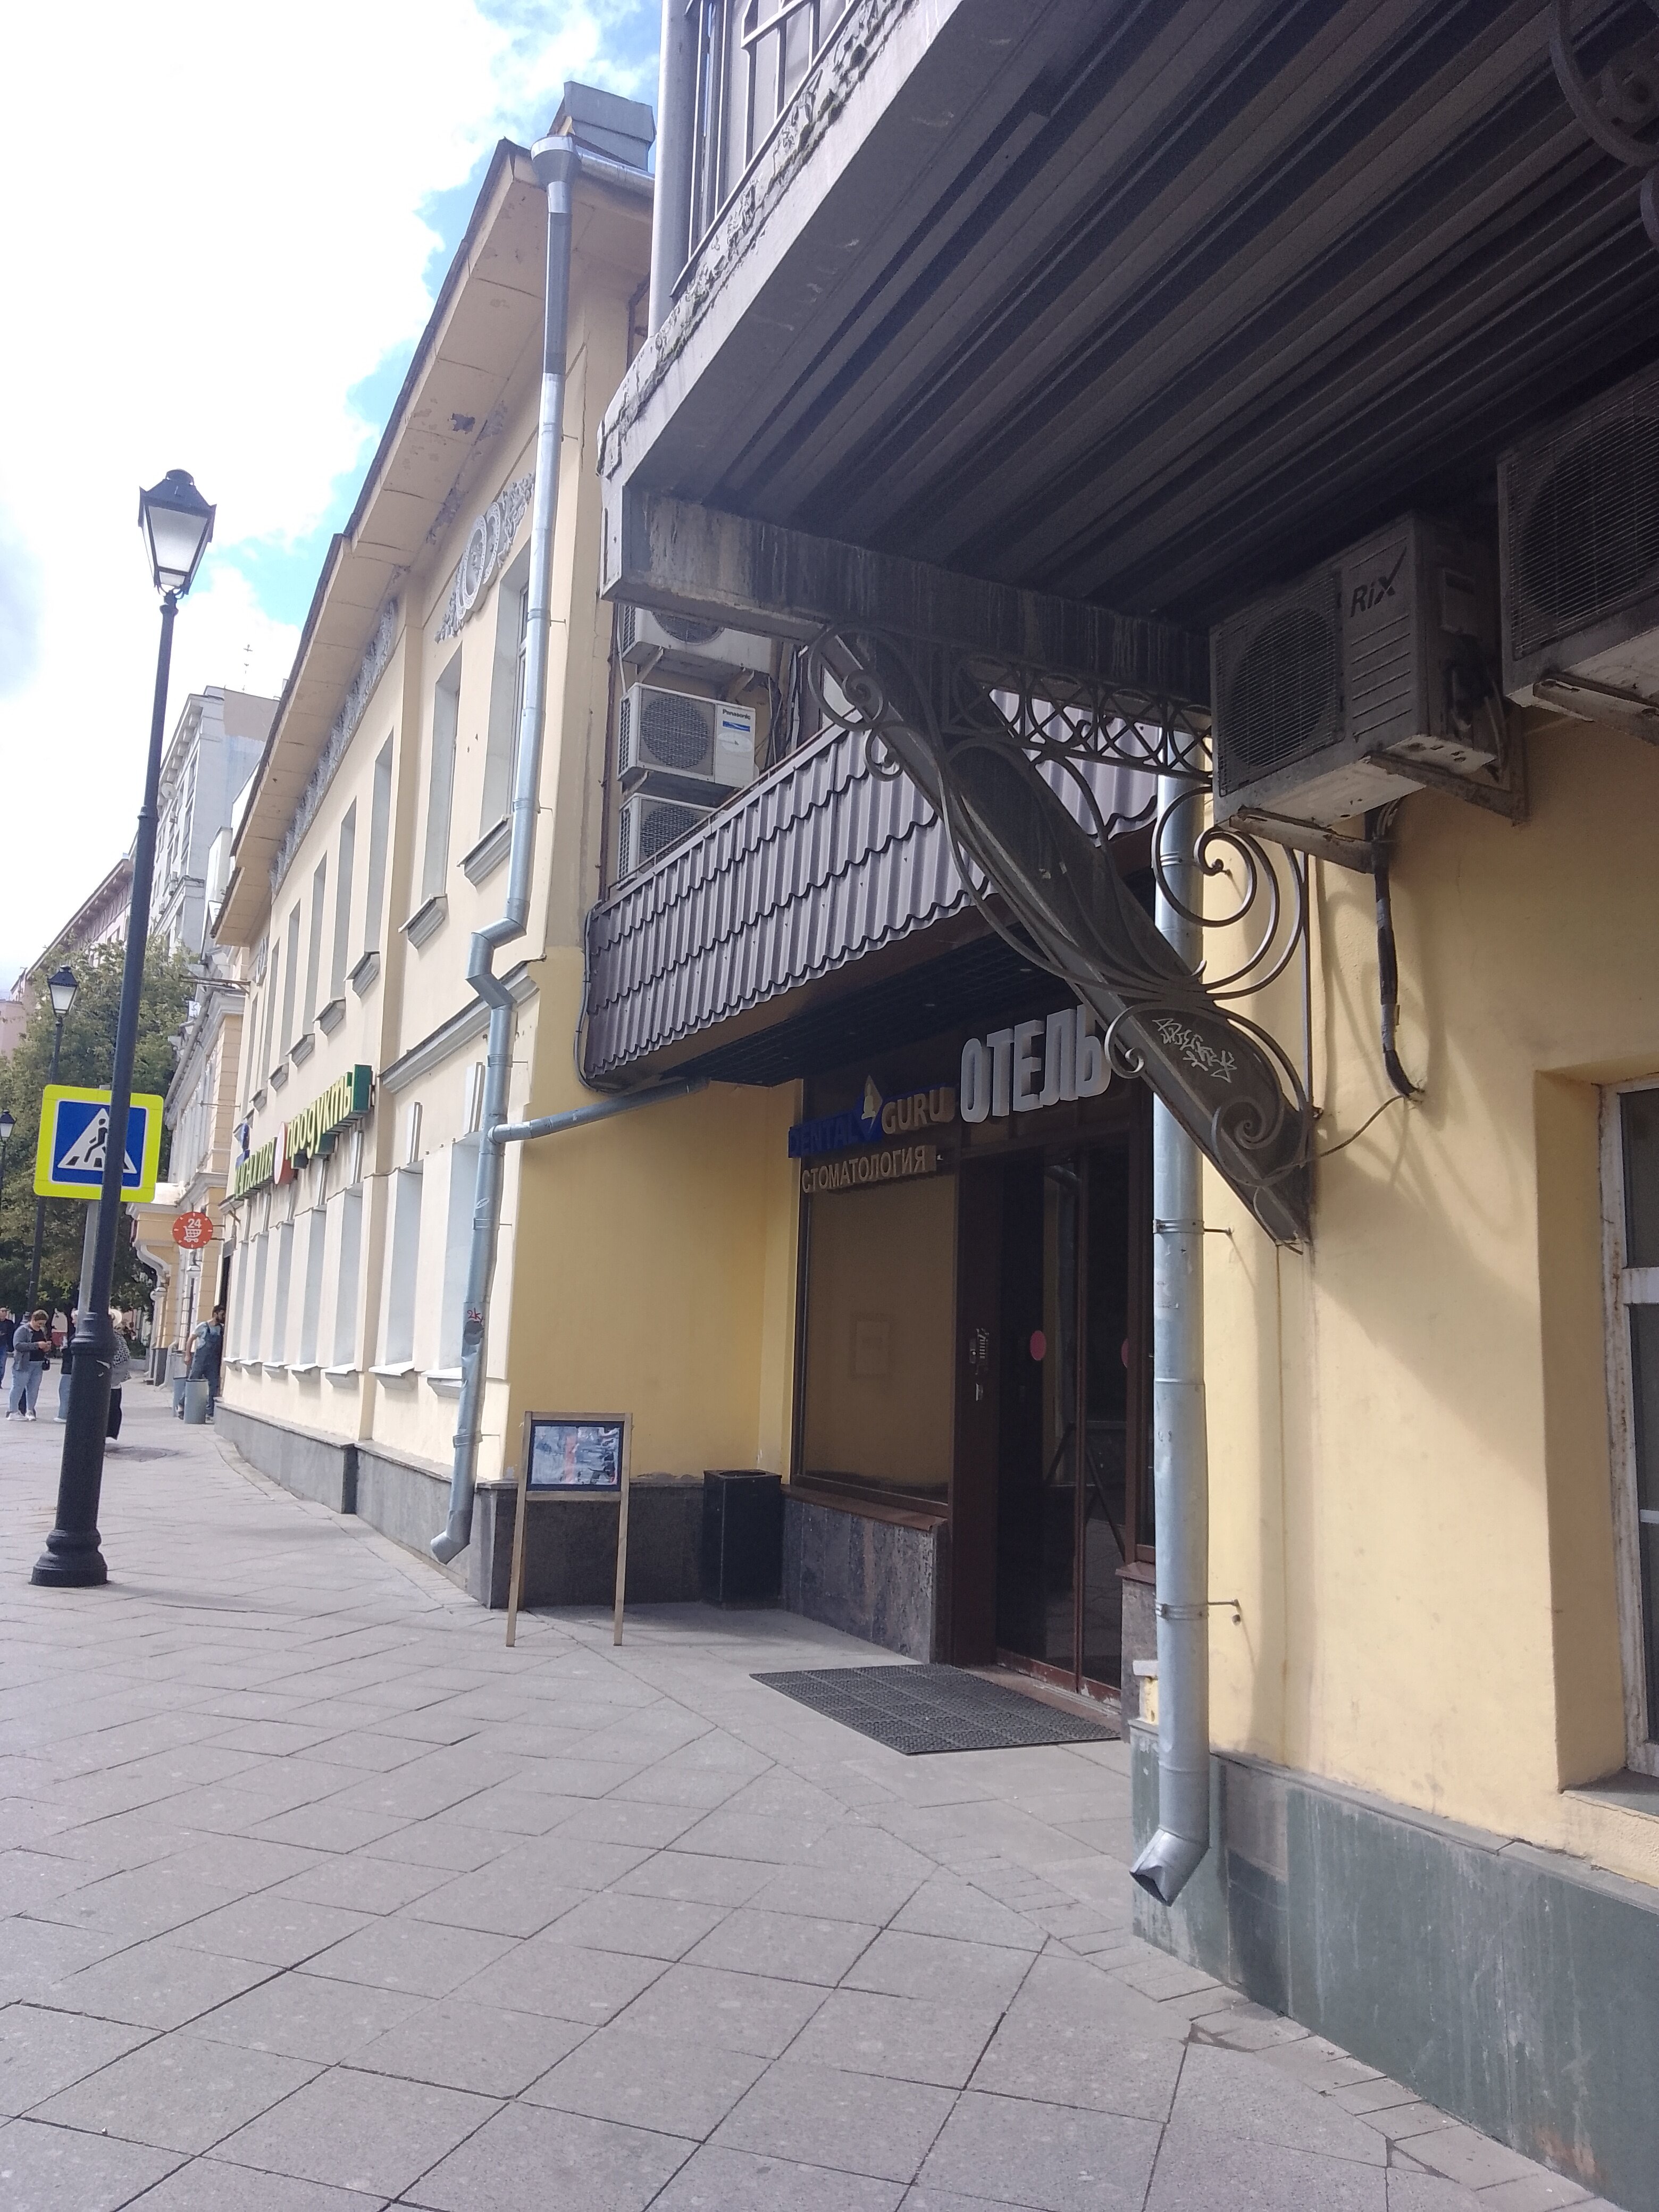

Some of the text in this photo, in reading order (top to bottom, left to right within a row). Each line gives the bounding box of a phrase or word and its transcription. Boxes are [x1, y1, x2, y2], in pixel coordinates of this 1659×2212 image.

[722, 708, 751, 720] Panasonic
[960, 1004, 1112, 1123] ОТЕЛЬ
[286, 1064, 357, 1169] продукты
[882, 1087, 954, 1135] GURU
[802, 1145, 928, 1193] СТОМАТОЛОГИЯ
[187, 1218, 202, 1229] 24
